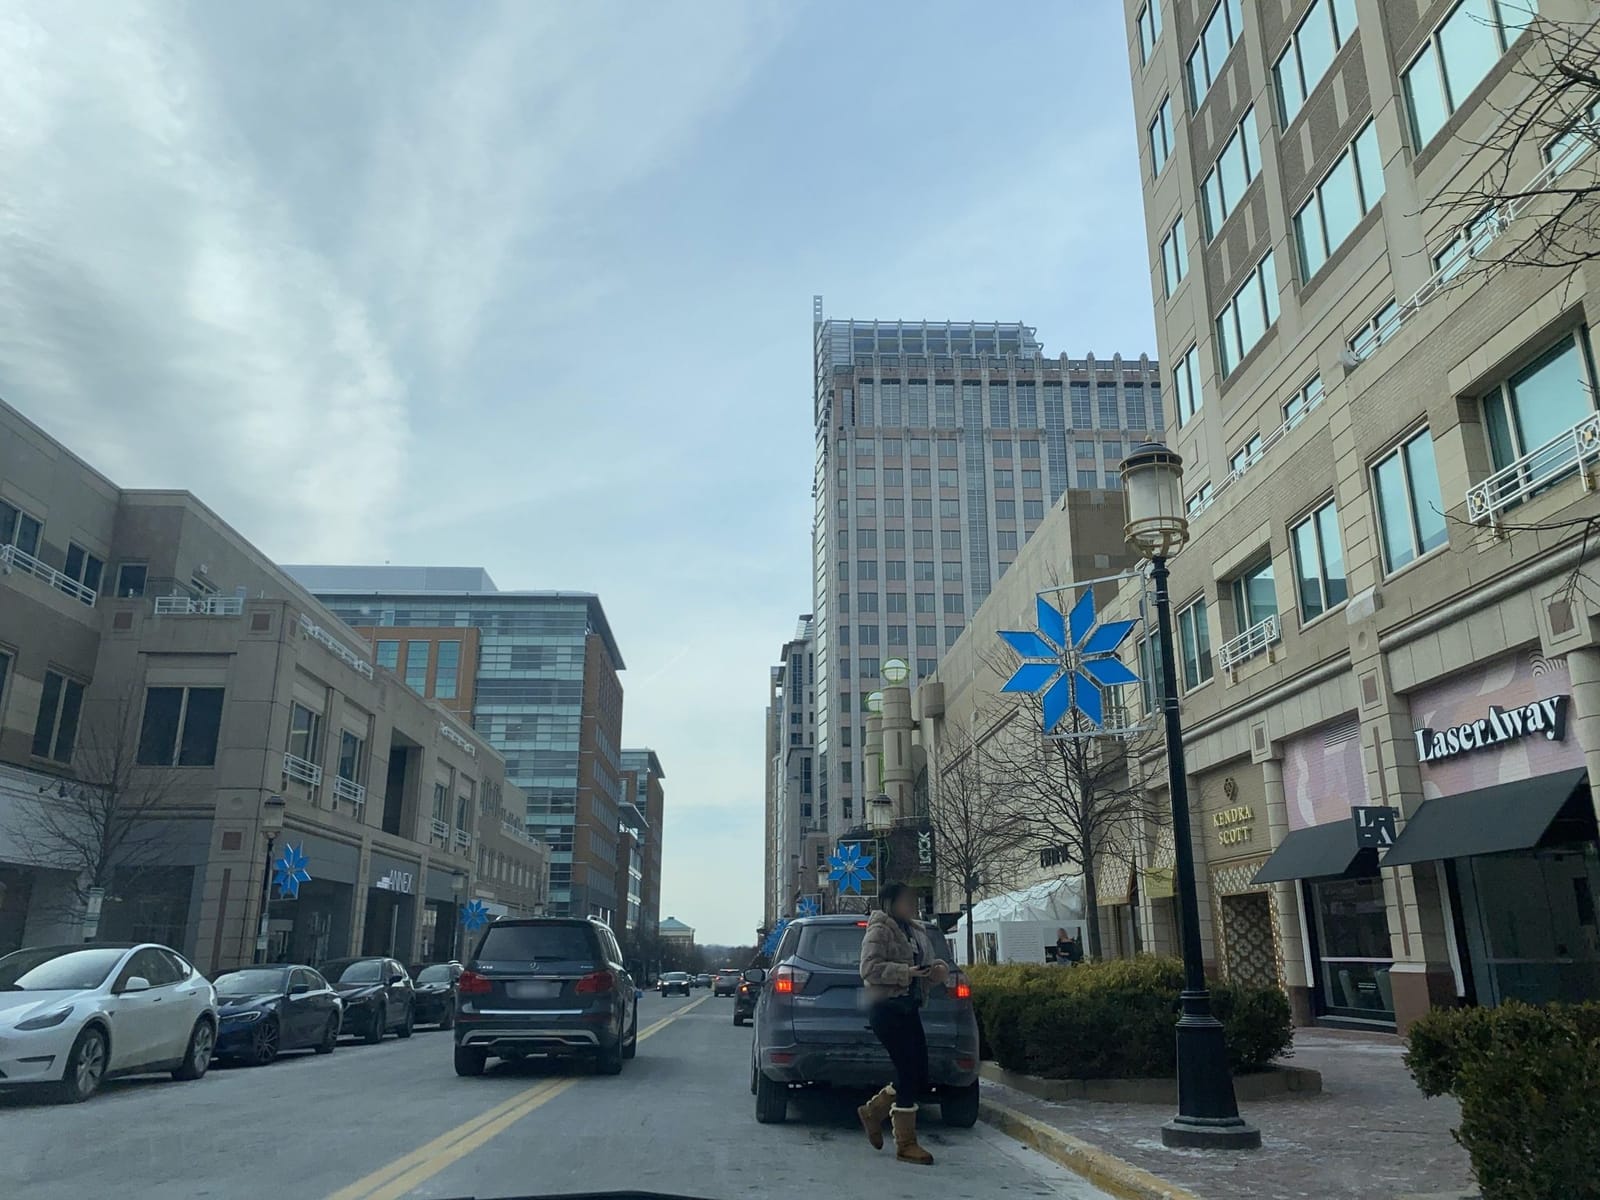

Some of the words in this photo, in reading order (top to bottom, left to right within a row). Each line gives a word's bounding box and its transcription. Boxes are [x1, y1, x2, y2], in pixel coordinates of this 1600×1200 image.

[1414, 696, 1562, 762] LaserAway
[1212, 805, 1253, 827] KENDRA
[1219, 826, 1249, 845] SCOTT
